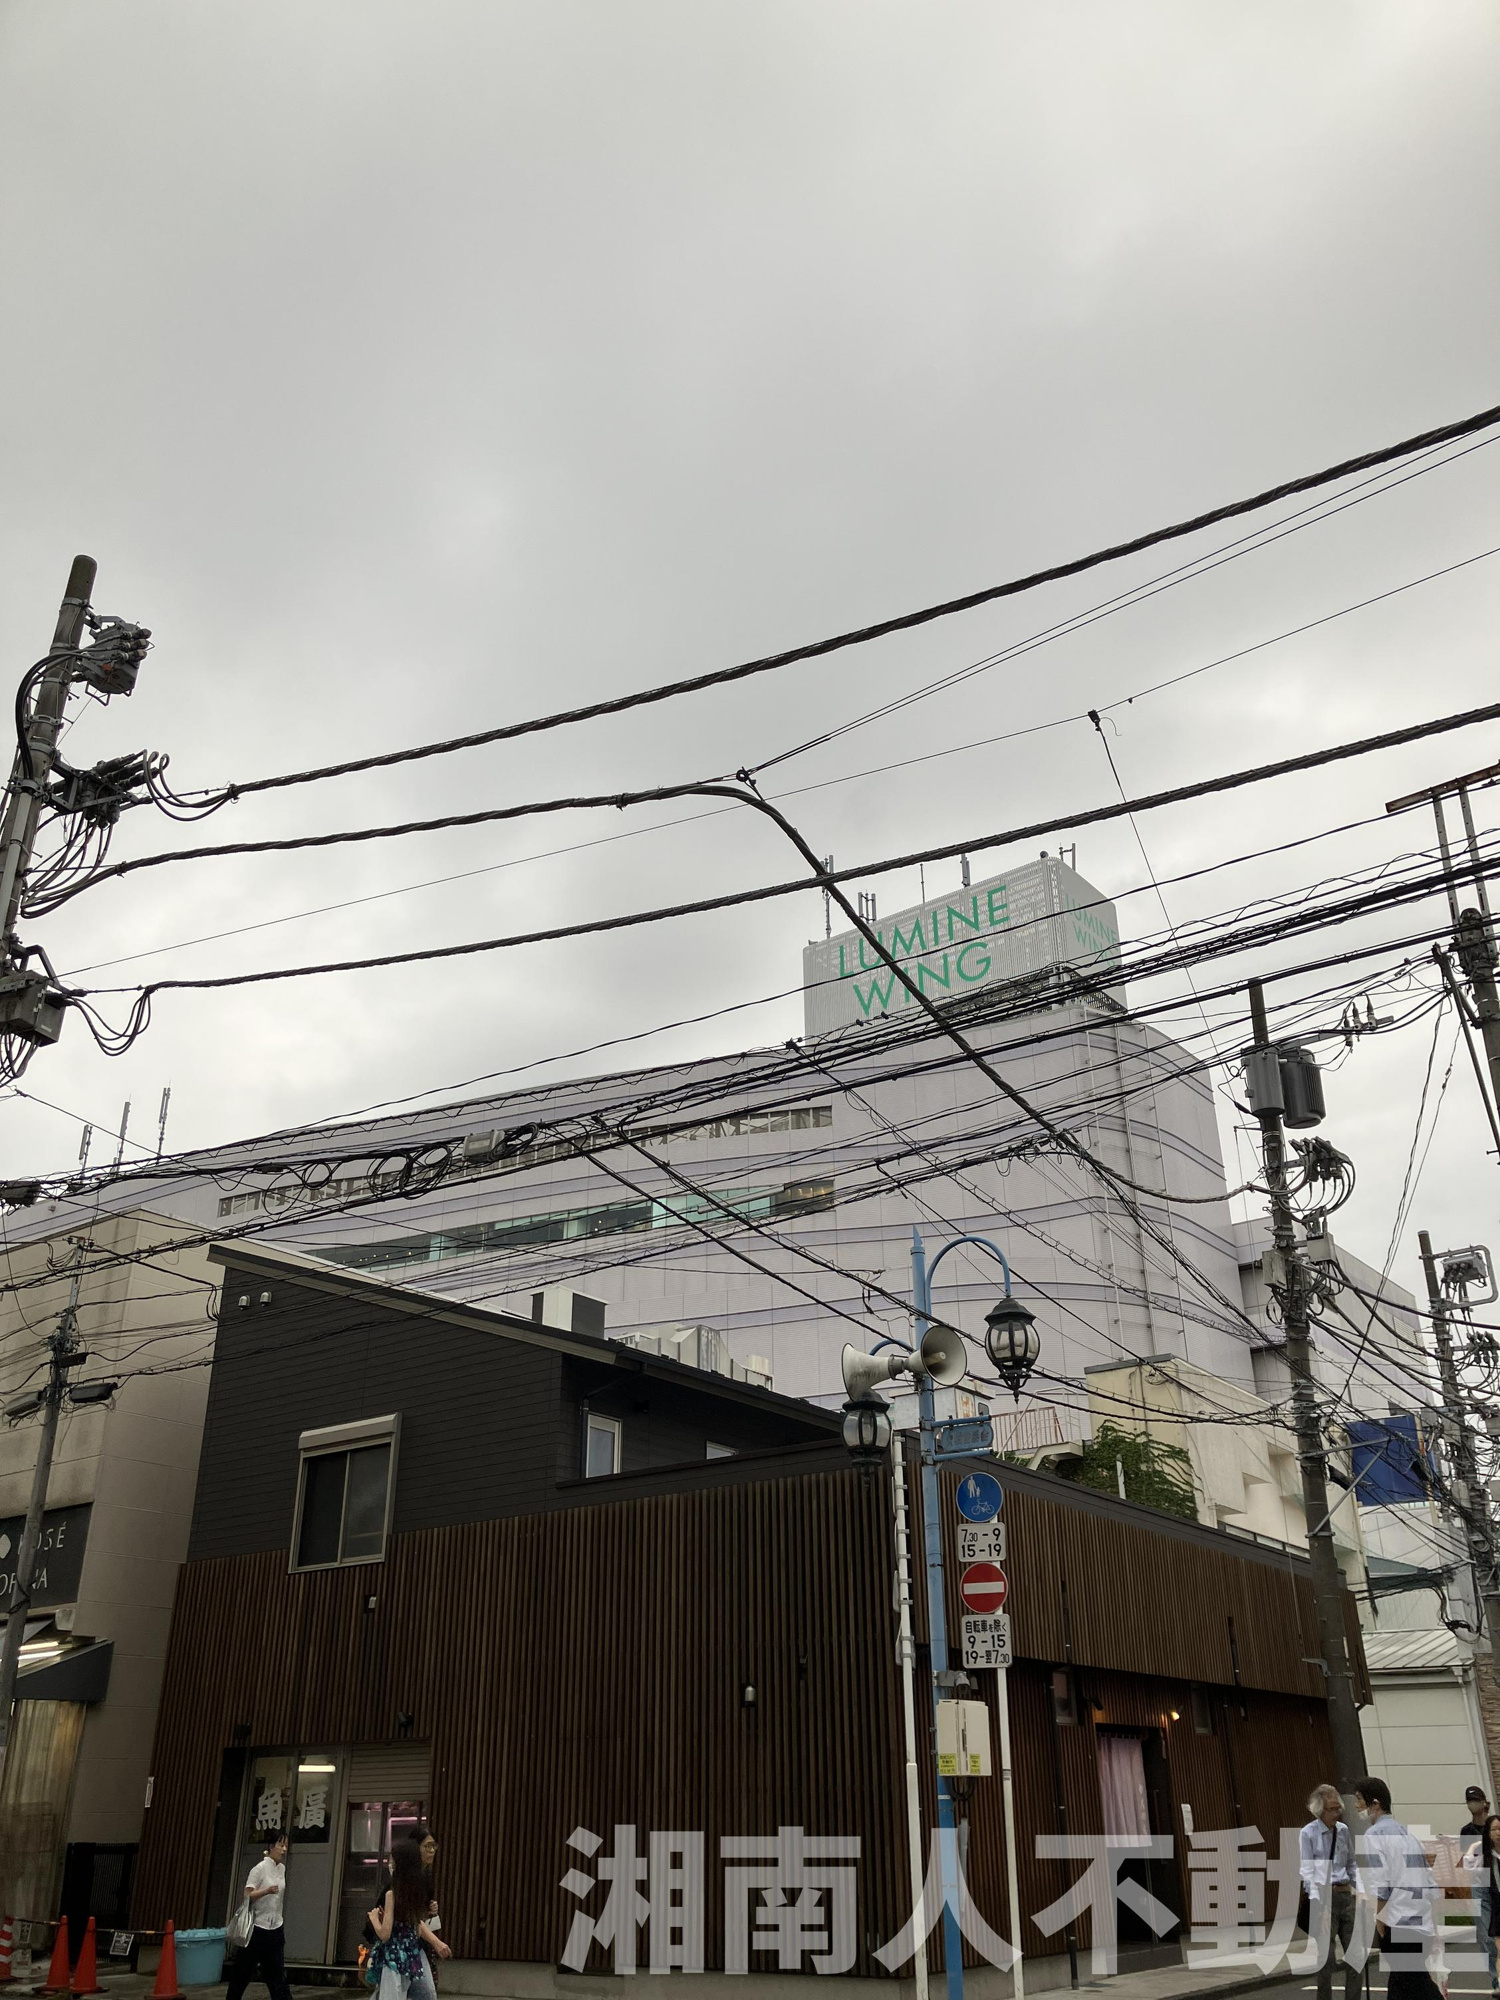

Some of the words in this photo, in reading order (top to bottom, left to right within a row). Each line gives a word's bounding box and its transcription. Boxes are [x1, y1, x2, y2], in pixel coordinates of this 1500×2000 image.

[839, 885, 1010, 977] LUMINE
[853, 941, 991, 1016] WING
[965, 1619, 1007, 1634] 自転車を除く
